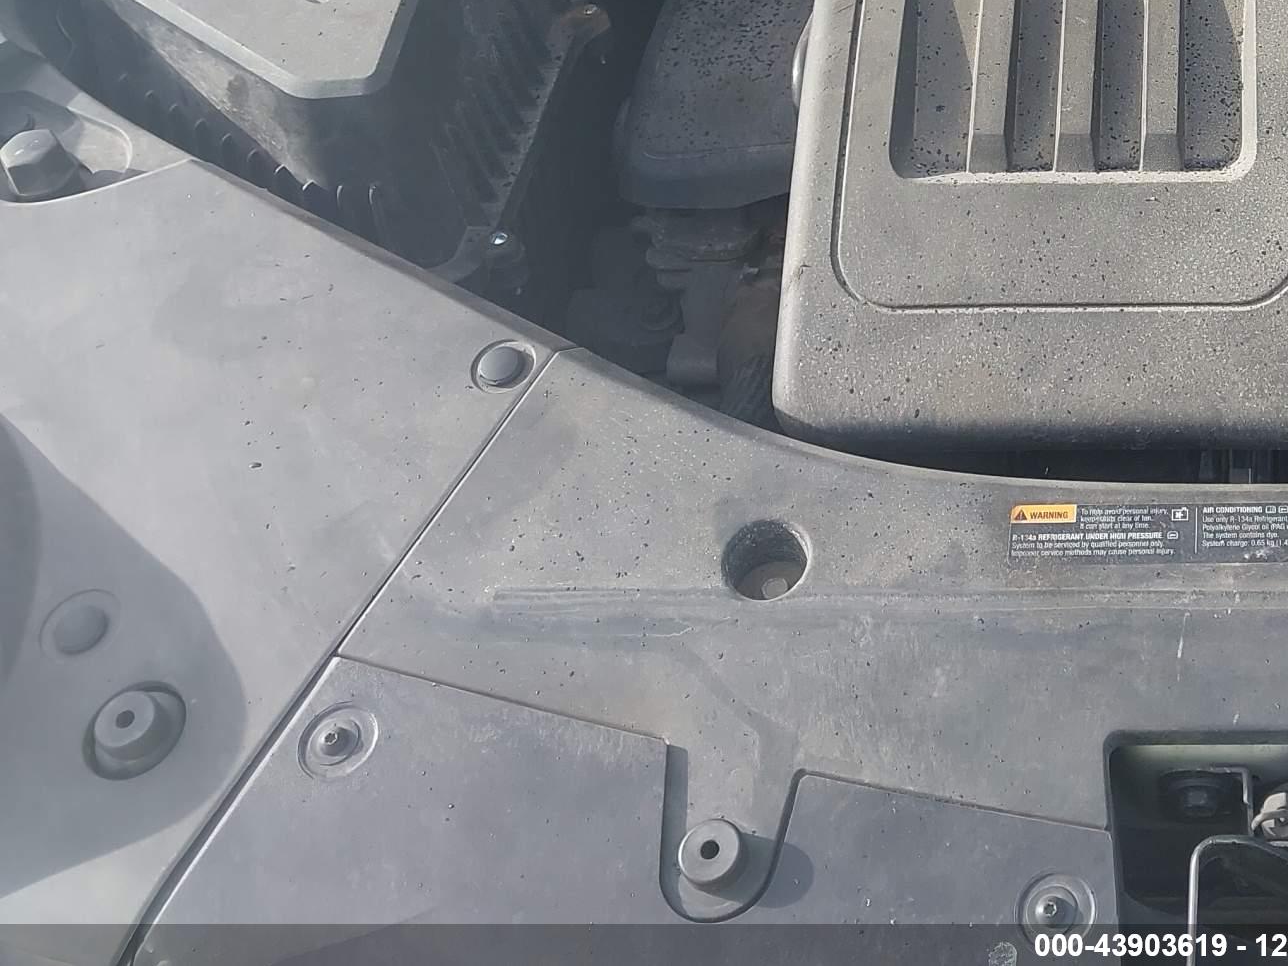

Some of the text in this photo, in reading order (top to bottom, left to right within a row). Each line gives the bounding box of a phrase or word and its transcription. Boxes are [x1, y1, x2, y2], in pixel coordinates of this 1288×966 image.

[1202, 506, 1262, 514] AIR CONDITIONING
[1029, 511, 1069, 520] WARNING
